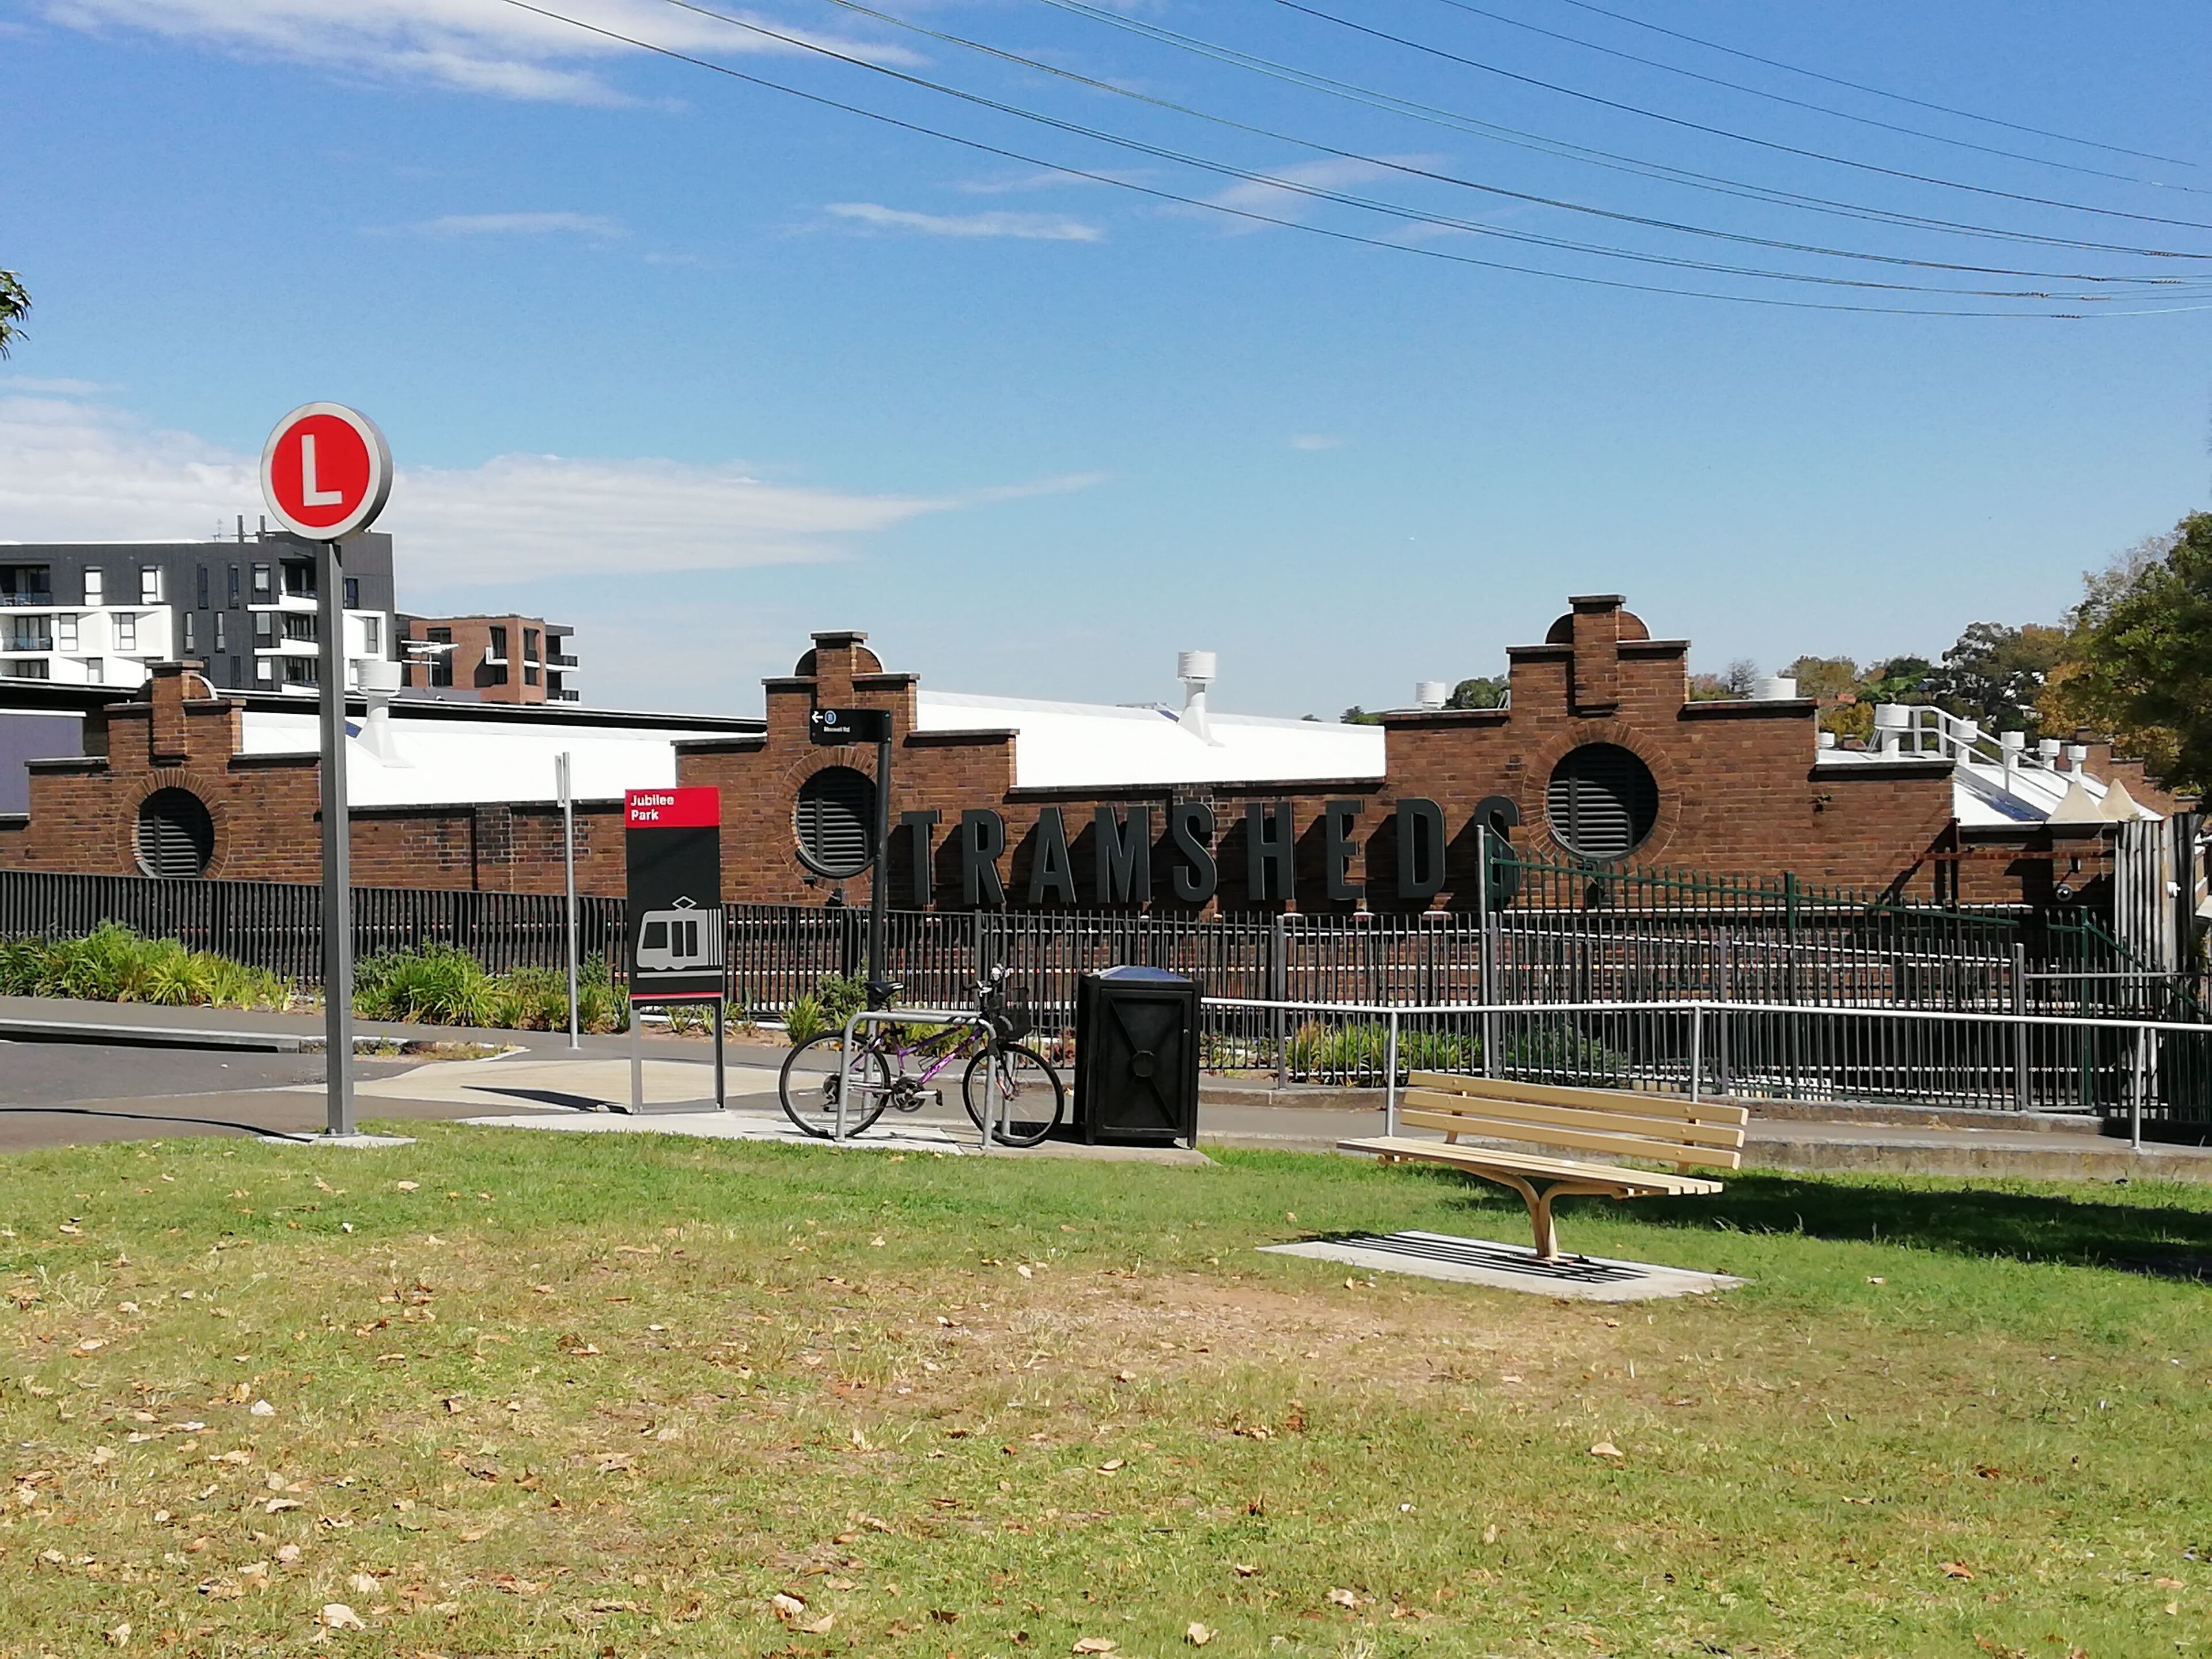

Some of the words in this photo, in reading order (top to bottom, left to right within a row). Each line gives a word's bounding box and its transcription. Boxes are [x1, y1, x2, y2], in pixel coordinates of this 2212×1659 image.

[301, 434, 343, 507] L
[630, 794, 675, 806] Jubilee
[631, 809, 660, 821] Park
[901, 794, 1522, 905] TRAMSHEDS
